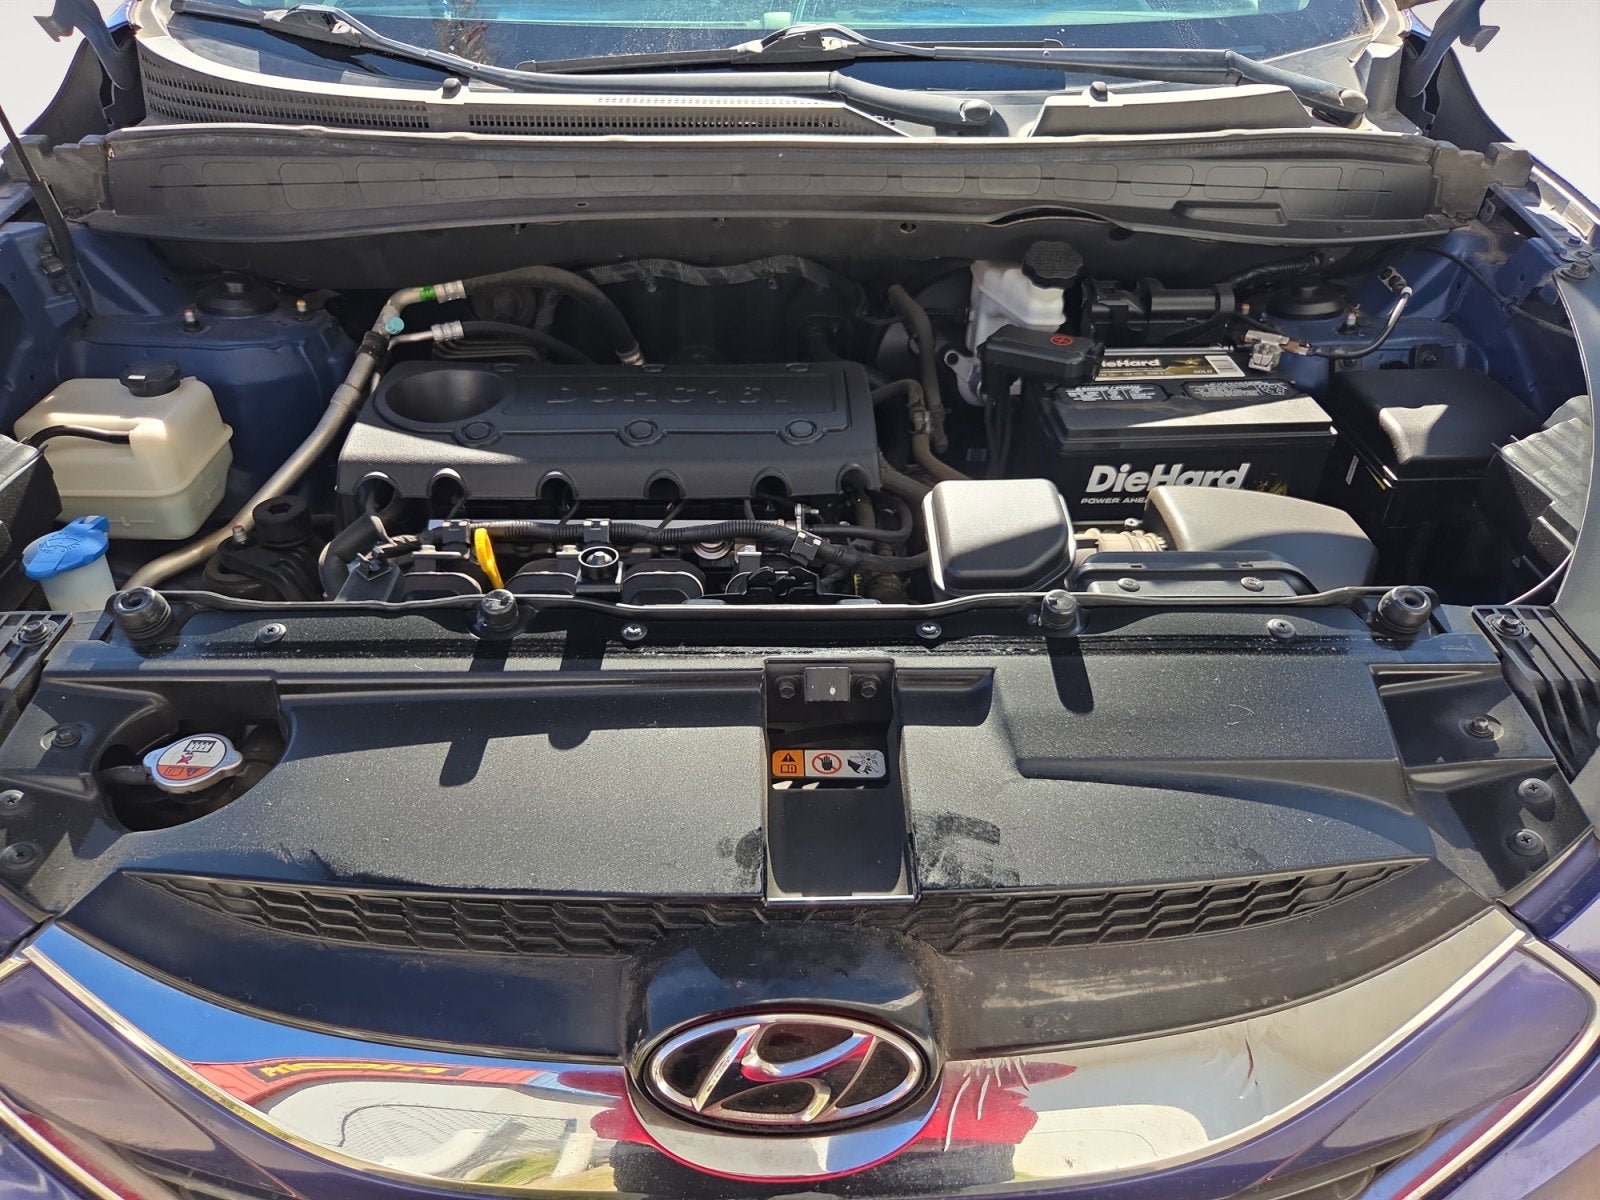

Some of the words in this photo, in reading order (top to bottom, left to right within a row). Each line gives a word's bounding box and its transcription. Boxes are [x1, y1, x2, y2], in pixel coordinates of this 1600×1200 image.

[1101, 358, 1160, 368] ieHard
[1085, 463, 1250, 493] DieHard
[1081, 497, 1120, 505] POWER
